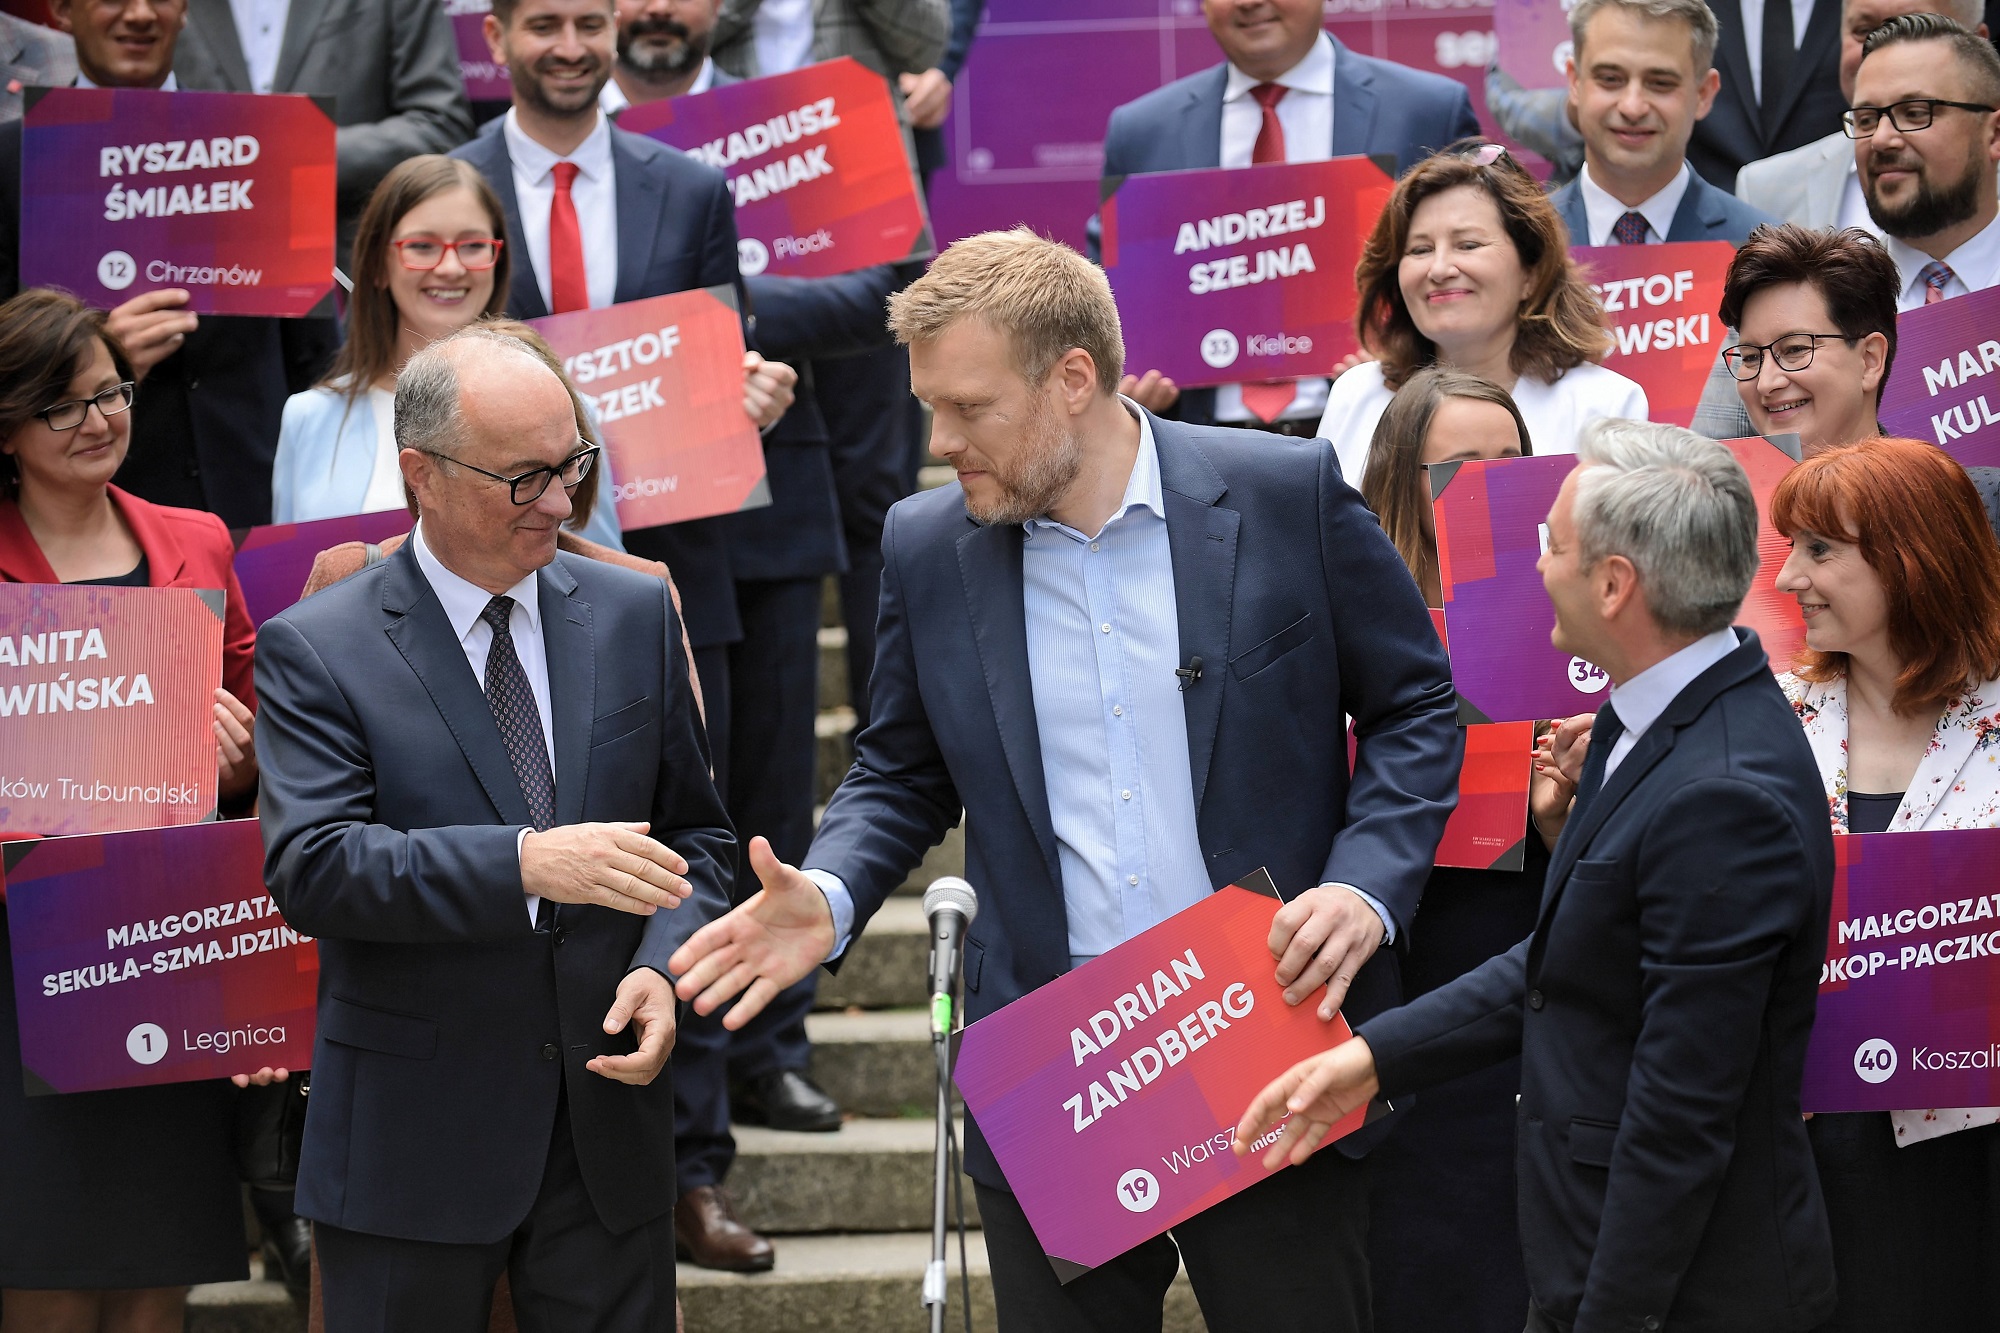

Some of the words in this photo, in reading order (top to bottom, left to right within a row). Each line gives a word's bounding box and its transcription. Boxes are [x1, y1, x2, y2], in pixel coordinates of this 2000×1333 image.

[100, 135, 260, 177] RYSZARD
[103, 179, 254, 222] ŚMIAŁEK
[1173, 195, 1325, 255] ANDRZEJ
[107, 261, 127, 278] 12
[145, 259, 263, 286] Chrzanów
[1189, 243, 1316, 295] SZEJNA
[1246, 332, 1313, 356] Kielce
[1930, 394, 2000, 446] KUL
[0, 628, 107, 667] ANITA
[57, 778, 199, 805] Trubunalski
[1070, 948, 1206, 1068] ADRIAN
[141, 1033, 153, 1052] 1
[183, 1024, 286, 1054] Legnica
[1061, 982, 1255, 1134] ZANDBERG
[1859, 1048, 1892, 1071] 40
[1123, 1176, 1149, 1203] 19
[1161, 1121, 1243, 1175] Warsz
